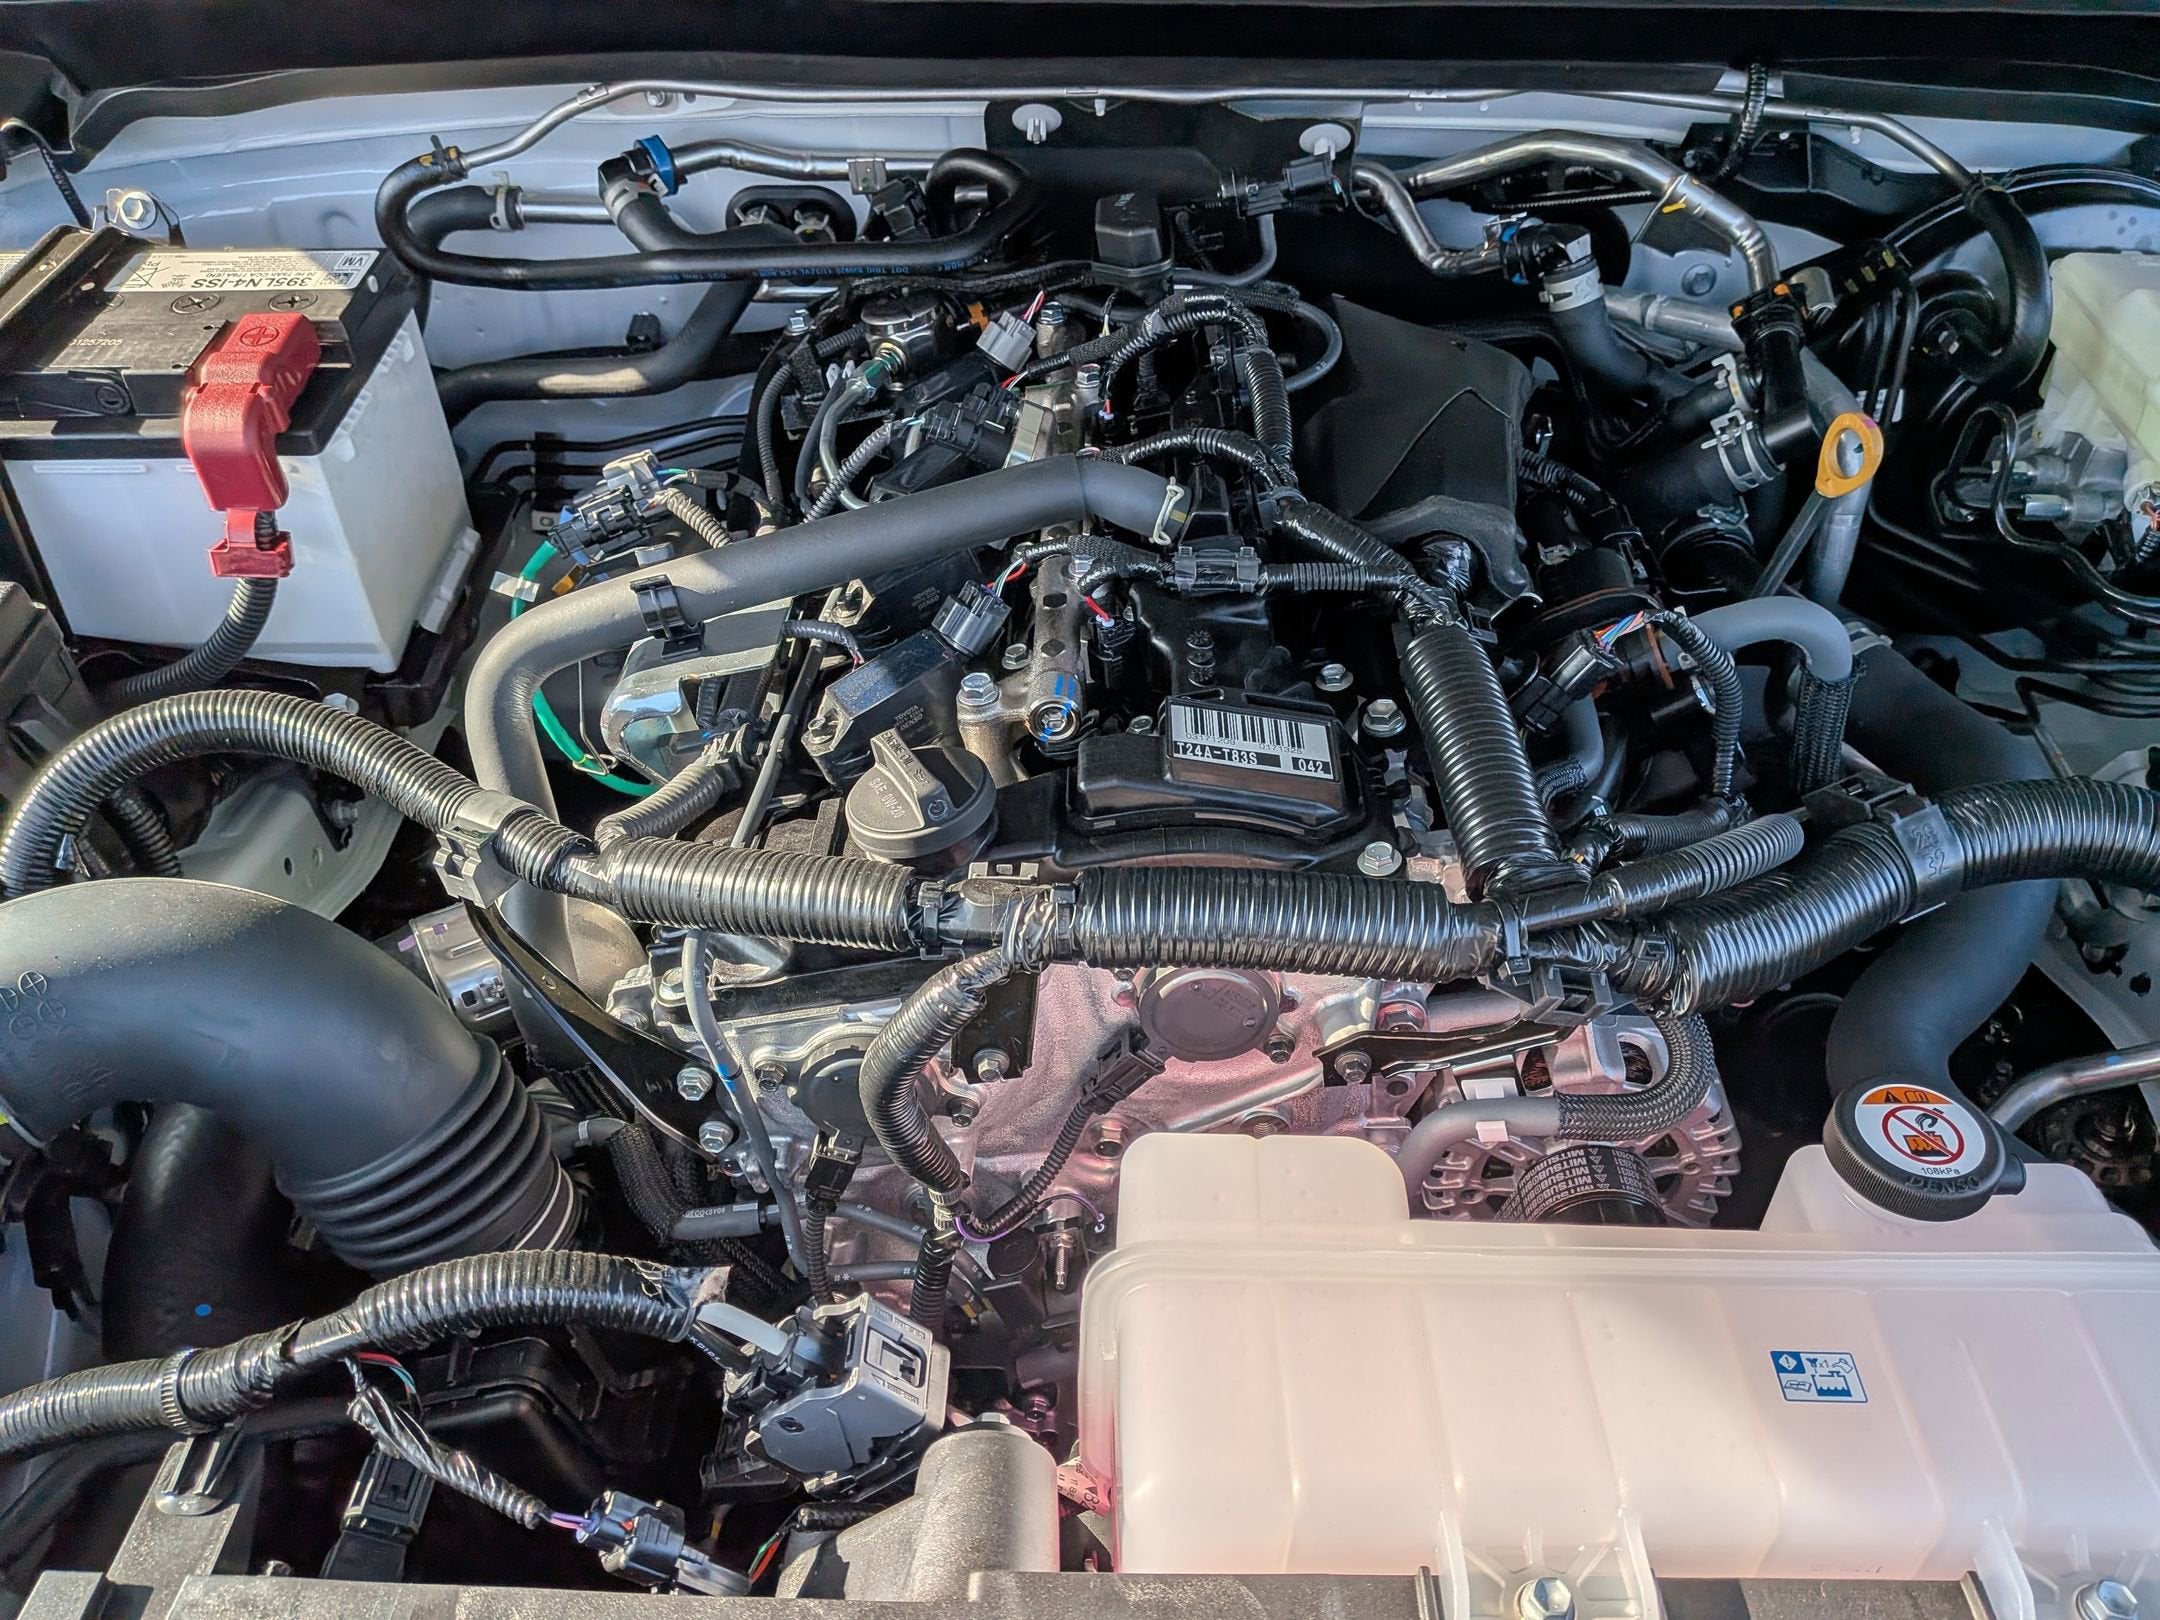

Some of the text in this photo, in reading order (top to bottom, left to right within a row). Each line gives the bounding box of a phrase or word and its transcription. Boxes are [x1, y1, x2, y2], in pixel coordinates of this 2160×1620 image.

[342, 256, 364, 267] VM
[190, 277, 312, 289] 395LN4-ISS
[895, 704, 919, 721] TOYOTA
[900, 713, 923, 731] DENSO
[881, 731, 915, 769] ENGINE OIL
[1185, 732, 1303, 755] 03171209 0171325
[1176, 741, 1325, 774] T24A-T83S 042
[868, 777, 906, 819] SAE 0W-20
[1520, 1156, 1588, 1198] MITSUBOSHI
[1920, 1167, 1961, 1176] 108kPa
[1522, 1165, 1591, 1208] MITSUBOSHI
[1525, 1174, 1593, 1217] MITSUBOSHI
[1905, 1175, 1981, 1195] DENSO
[1819, 1360, 1829, 1369] x1
